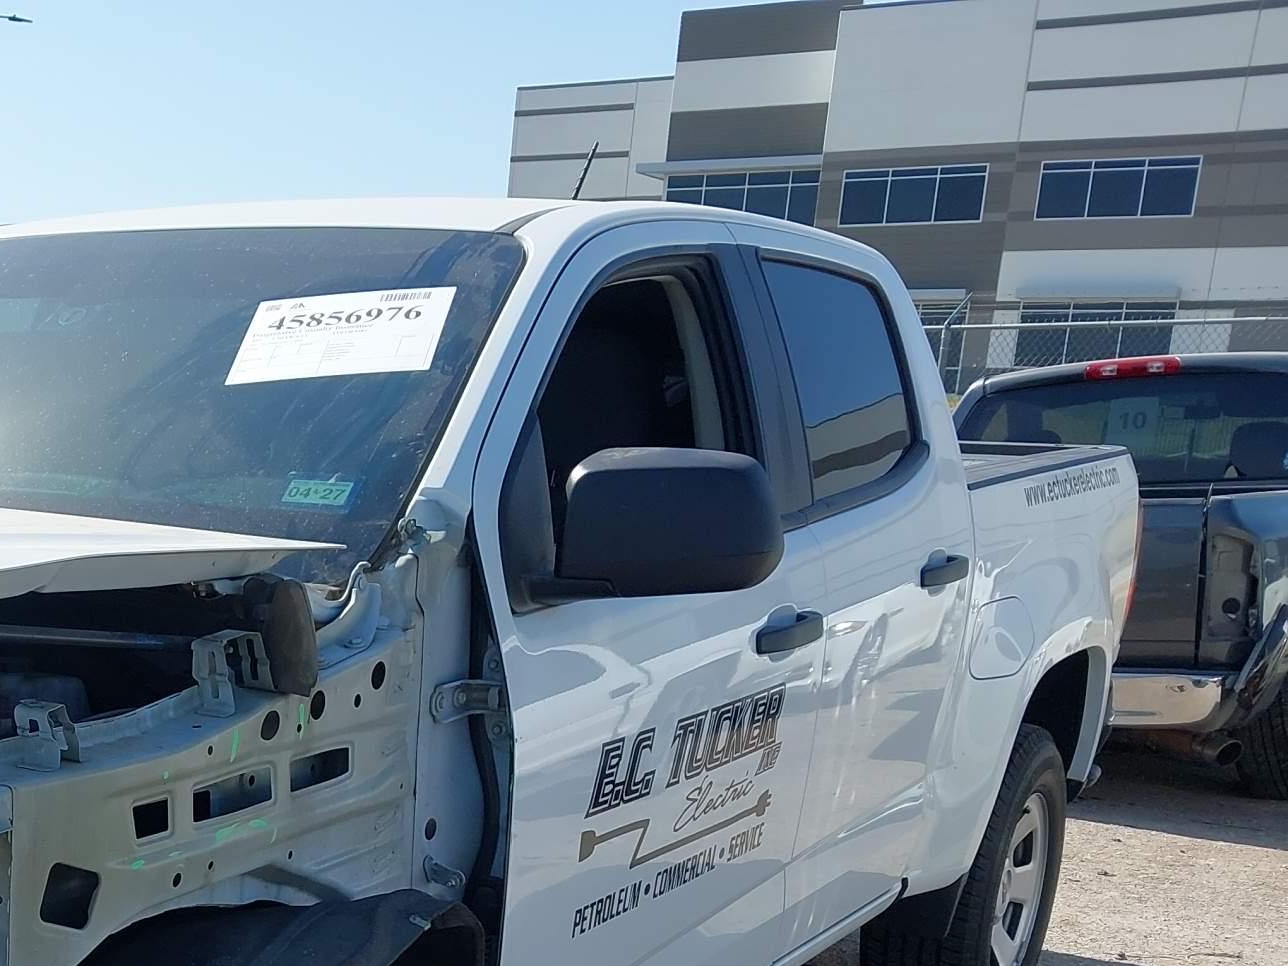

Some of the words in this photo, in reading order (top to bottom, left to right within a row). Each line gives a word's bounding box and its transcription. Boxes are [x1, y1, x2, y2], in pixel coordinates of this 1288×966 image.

[268, 305, 423, 330] 45856976
[1120, 412, 1147, 430] 10
[1024, 466, 1121, 507] www.ectuckerelectric.com
[665, 683, 786, 789] TUCKER
[673, 771, 754, 832] Electric
[572, 880, 642, 938] PETROLEUM
[653, 844, 717, 898] COMMERCIAL
[727, 823, 764, 862] SERVICE
